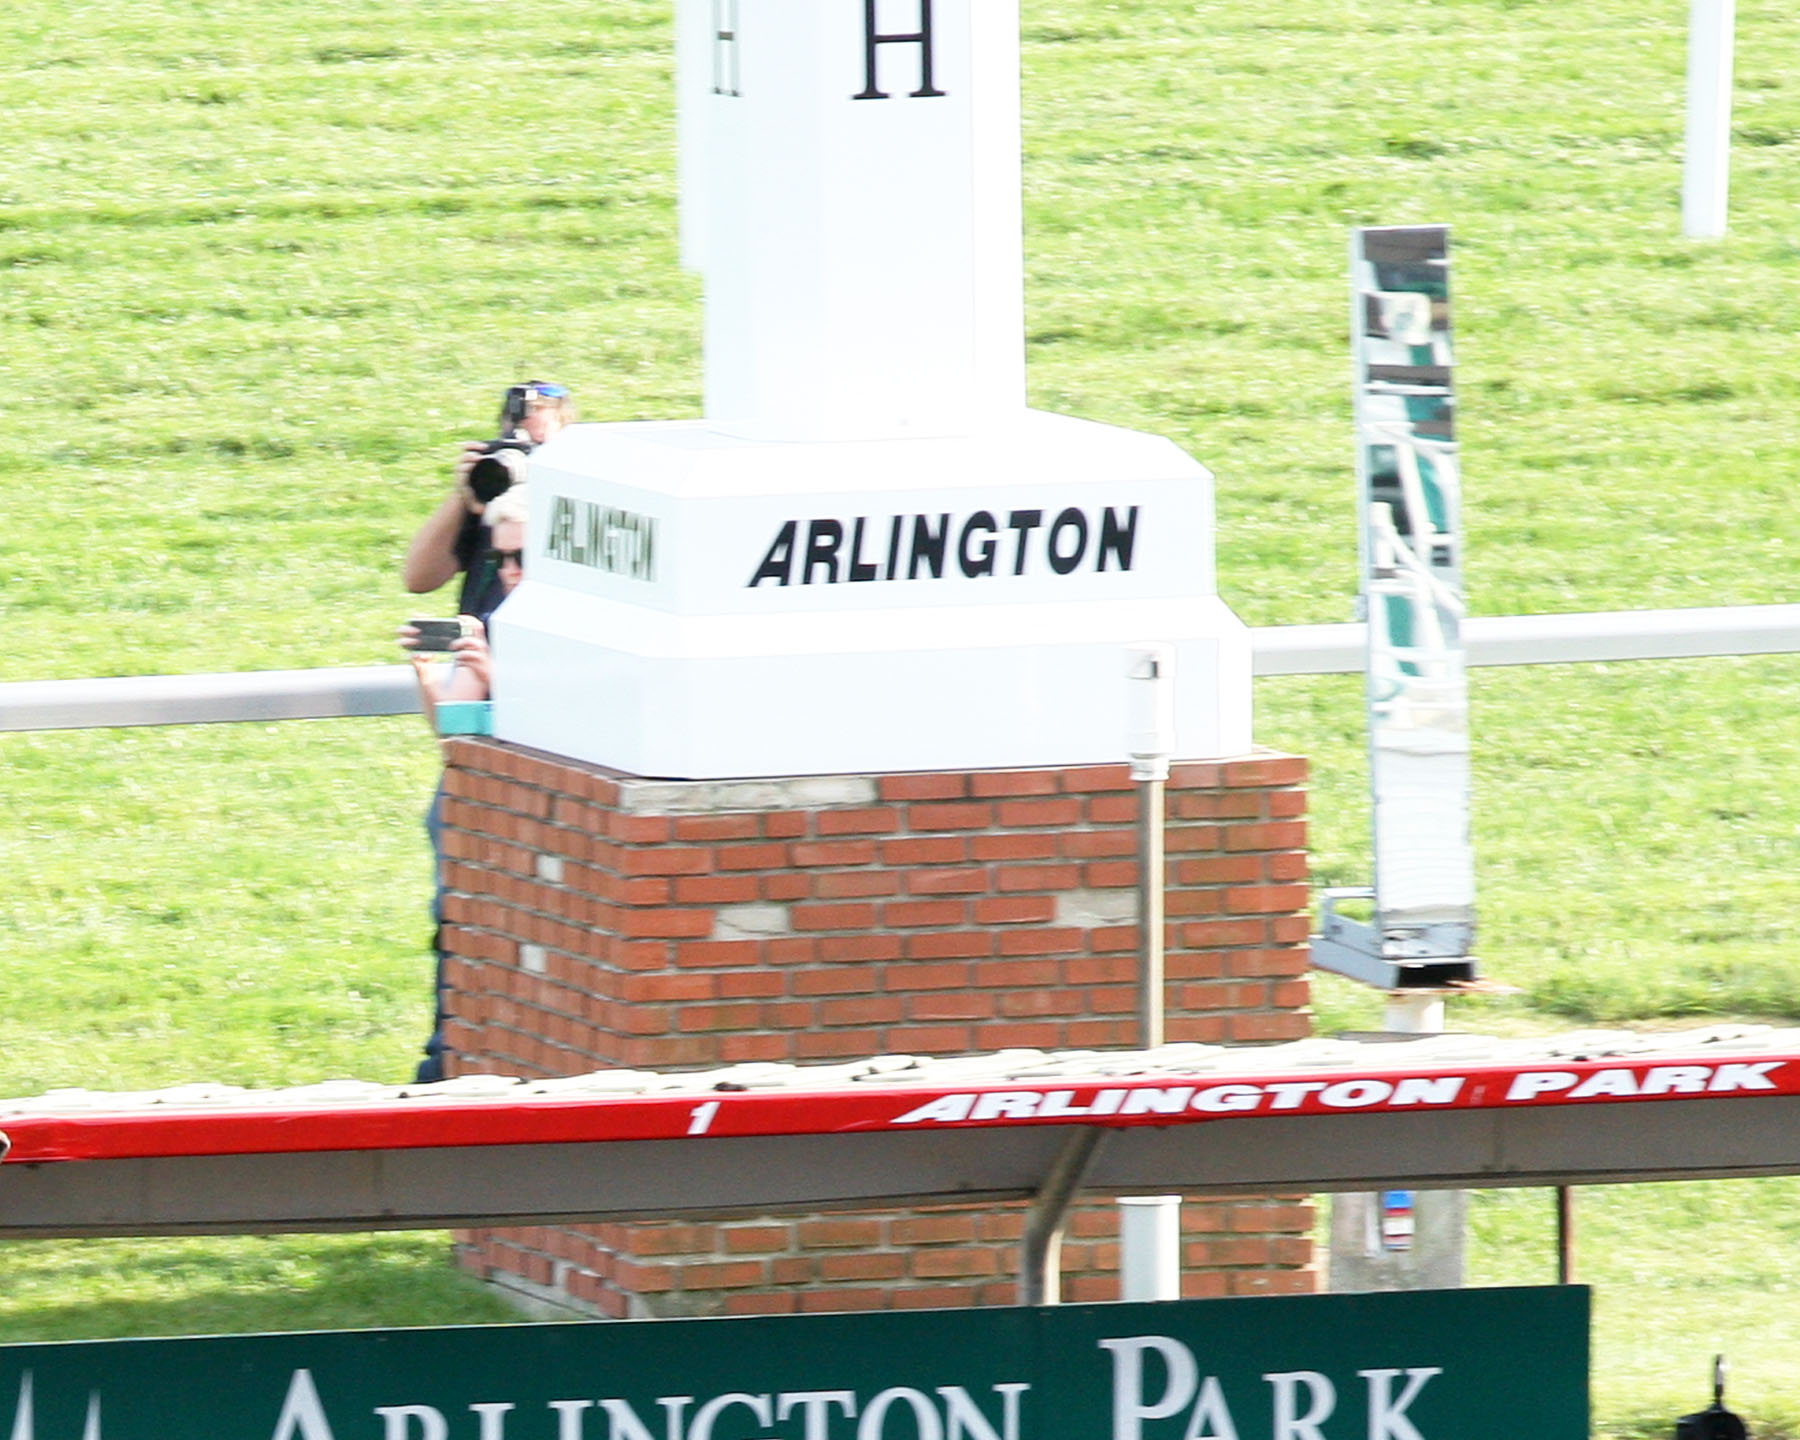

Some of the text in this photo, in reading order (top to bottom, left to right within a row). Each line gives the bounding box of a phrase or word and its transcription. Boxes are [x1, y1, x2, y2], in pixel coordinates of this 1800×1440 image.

[852, 0, 948, 100] H
[745, 505, 1141, 589] ARLINGTON
[686, 1101, 722, 1135] 1
[888, 1061, 1788, 1124] ARLINGTON PARK
